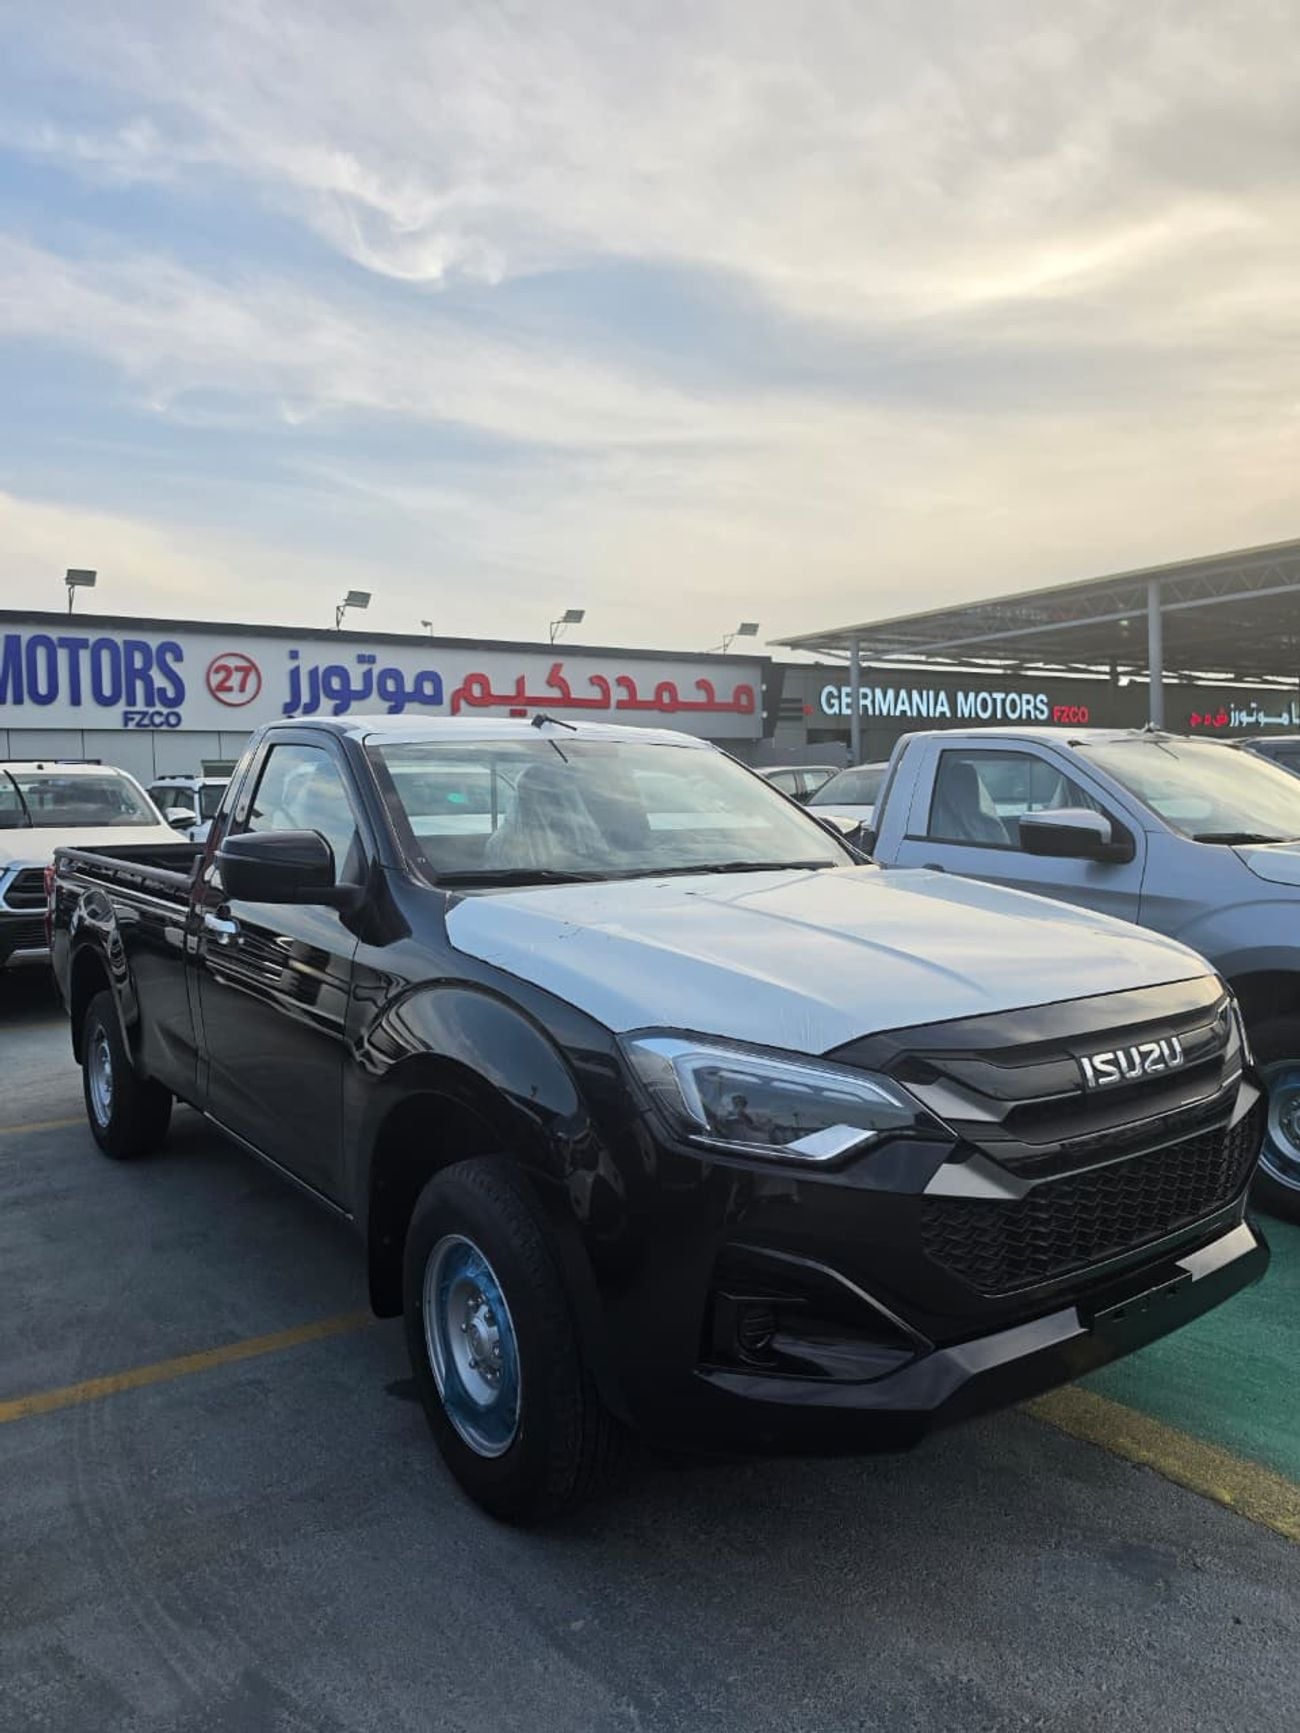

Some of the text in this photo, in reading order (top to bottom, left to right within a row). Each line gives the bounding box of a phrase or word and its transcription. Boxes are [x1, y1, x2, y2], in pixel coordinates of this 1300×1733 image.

[212, 665, 253, 693] 27
[283, 650, 756, 716] محمد حكيم موتورز
[122, 710, 182, 729] FZCO
[820, 685, 1089, 723] GERMANIA MOTORS FZCO
[1080, 1037, 1185, 1088] ISUZU
